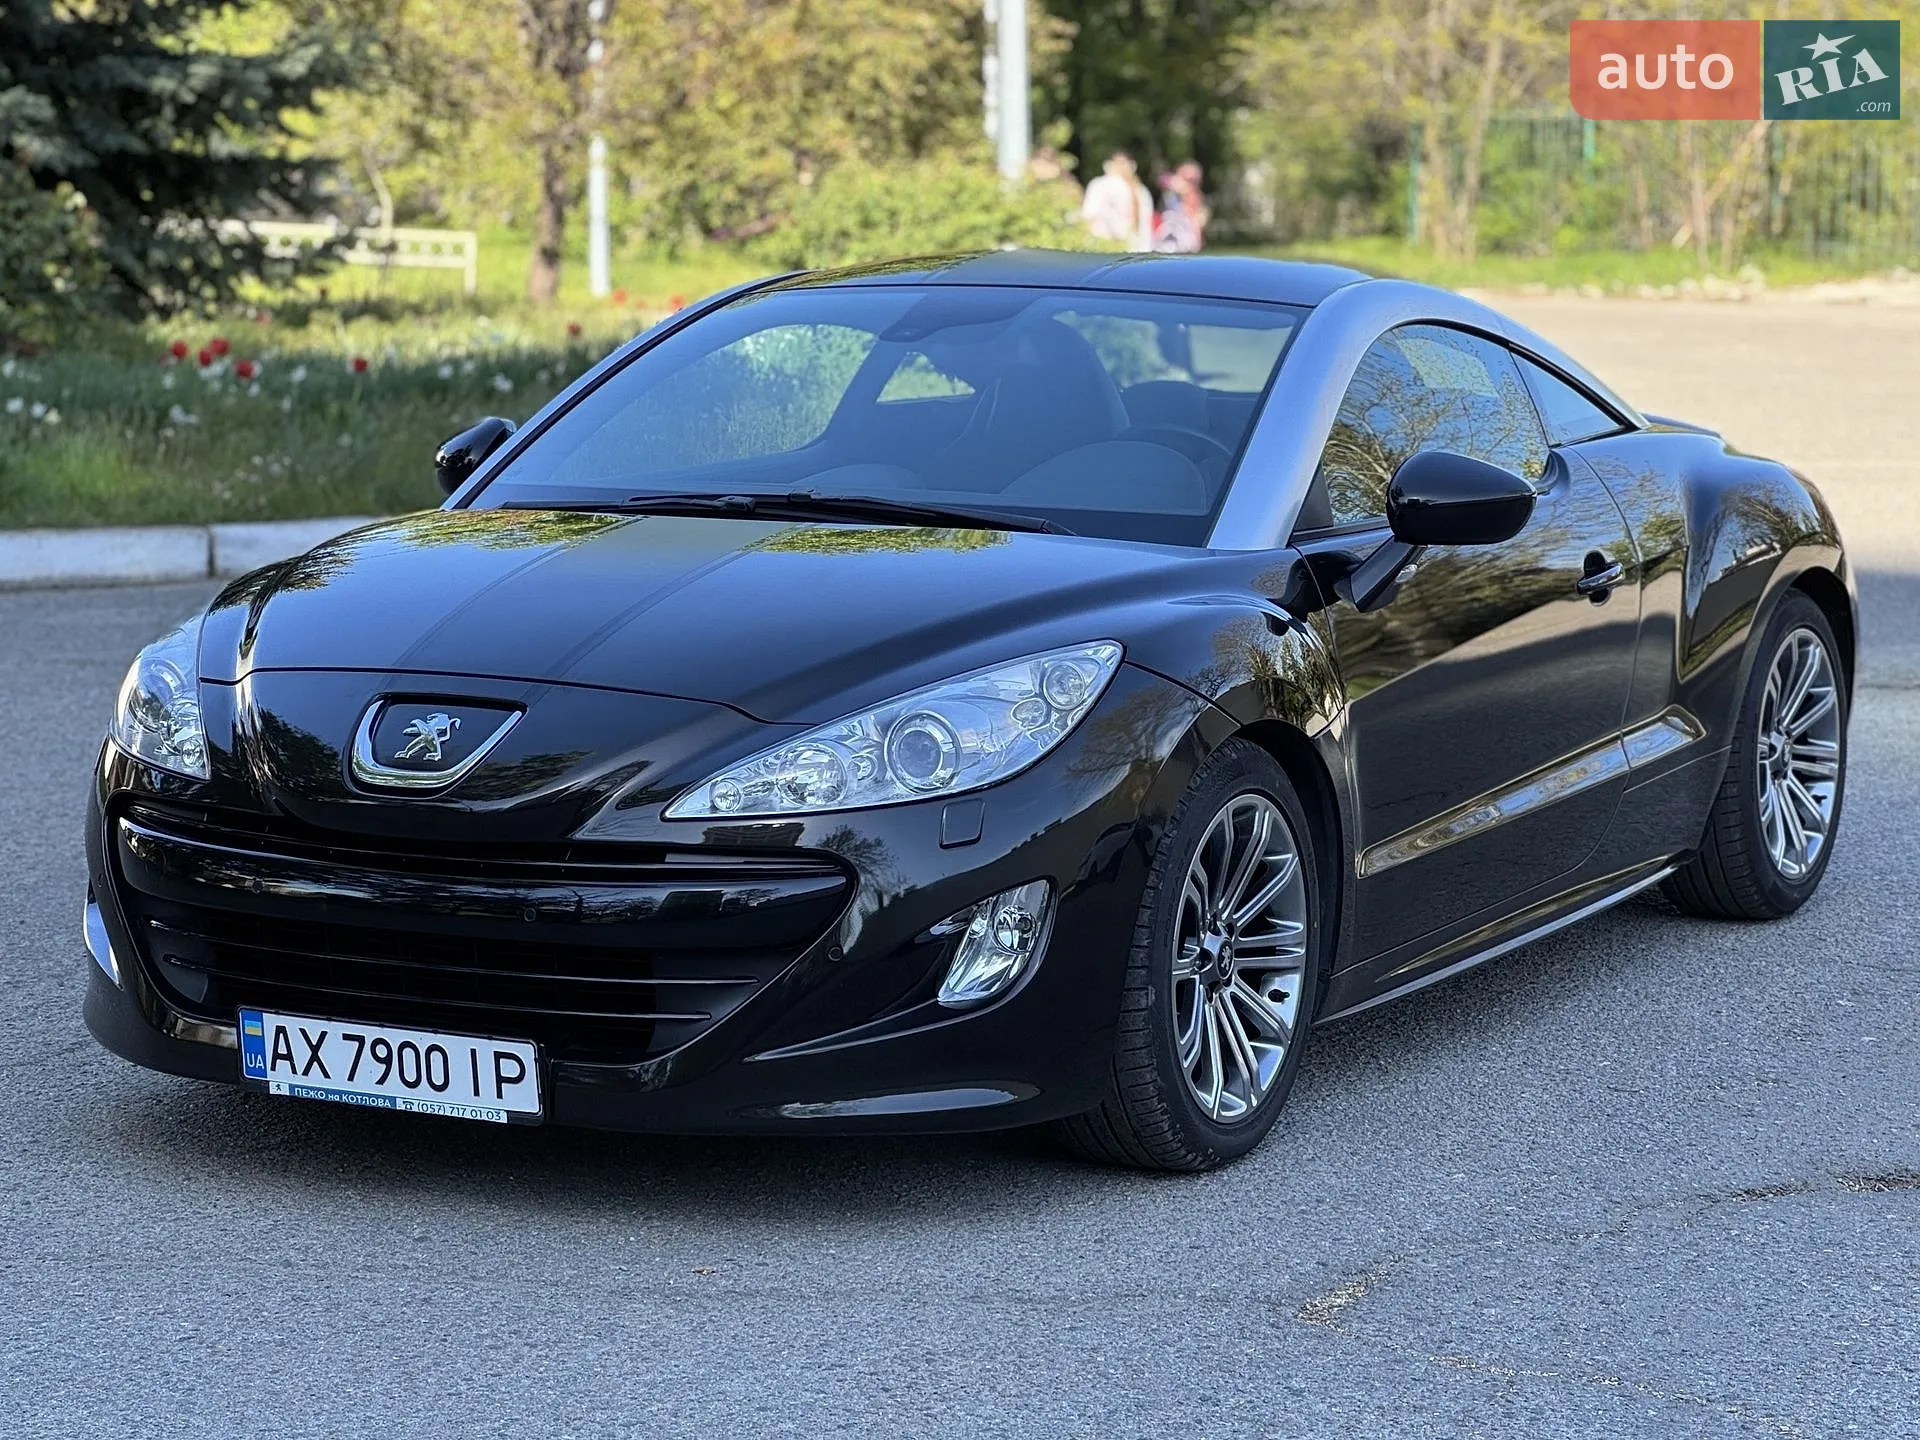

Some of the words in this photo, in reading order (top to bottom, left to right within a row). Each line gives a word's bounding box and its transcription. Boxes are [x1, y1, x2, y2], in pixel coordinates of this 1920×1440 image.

[246, 1052, 265, 1069] UA
[270, 1025, 331, 1080] AX
[342, 1033, 449, 1092] 7900
[470, 1048, 526, 1100] IP
[294, 1087, 326, 1100] ПЕЖО
[328, 1093, 340, 1101] на
[342, 1094, 391, 1108] КОТЛОВА
[417, 1102, 446, 1115] (057)
[446, 1106, 466, 1117] 717
[469, 1108, 485, 1119] 01
[486, 1110, 501, 1121] 03
